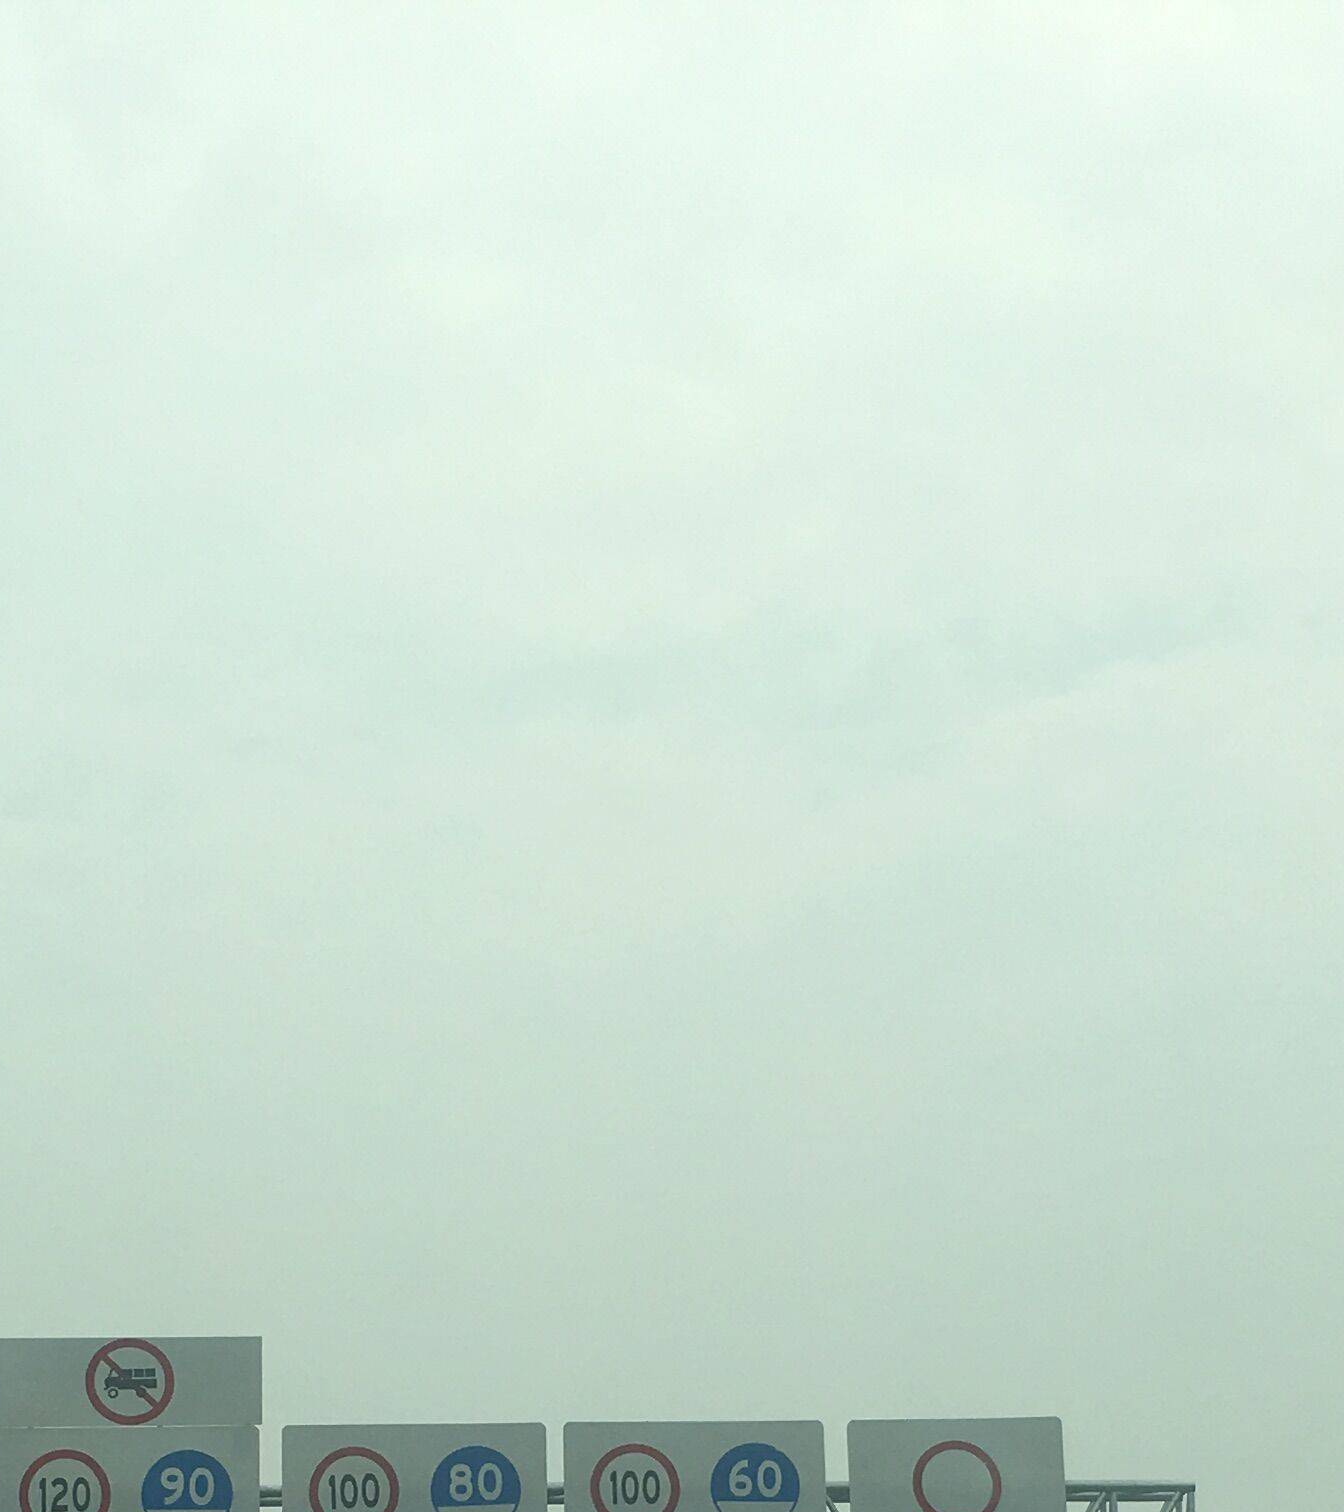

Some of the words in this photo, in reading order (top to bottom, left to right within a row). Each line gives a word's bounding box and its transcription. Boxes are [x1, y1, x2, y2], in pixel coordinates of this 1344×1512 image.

[38, 1476, 91, 1512] 120
[160, 1466, 215, 1505] 90
[327, 1473, 380, 1510] 100
[447, 1460, 502, 1501] 80
[609, 1469, 661, 1506] 100
[728, 1458, 783, 1498] 60
